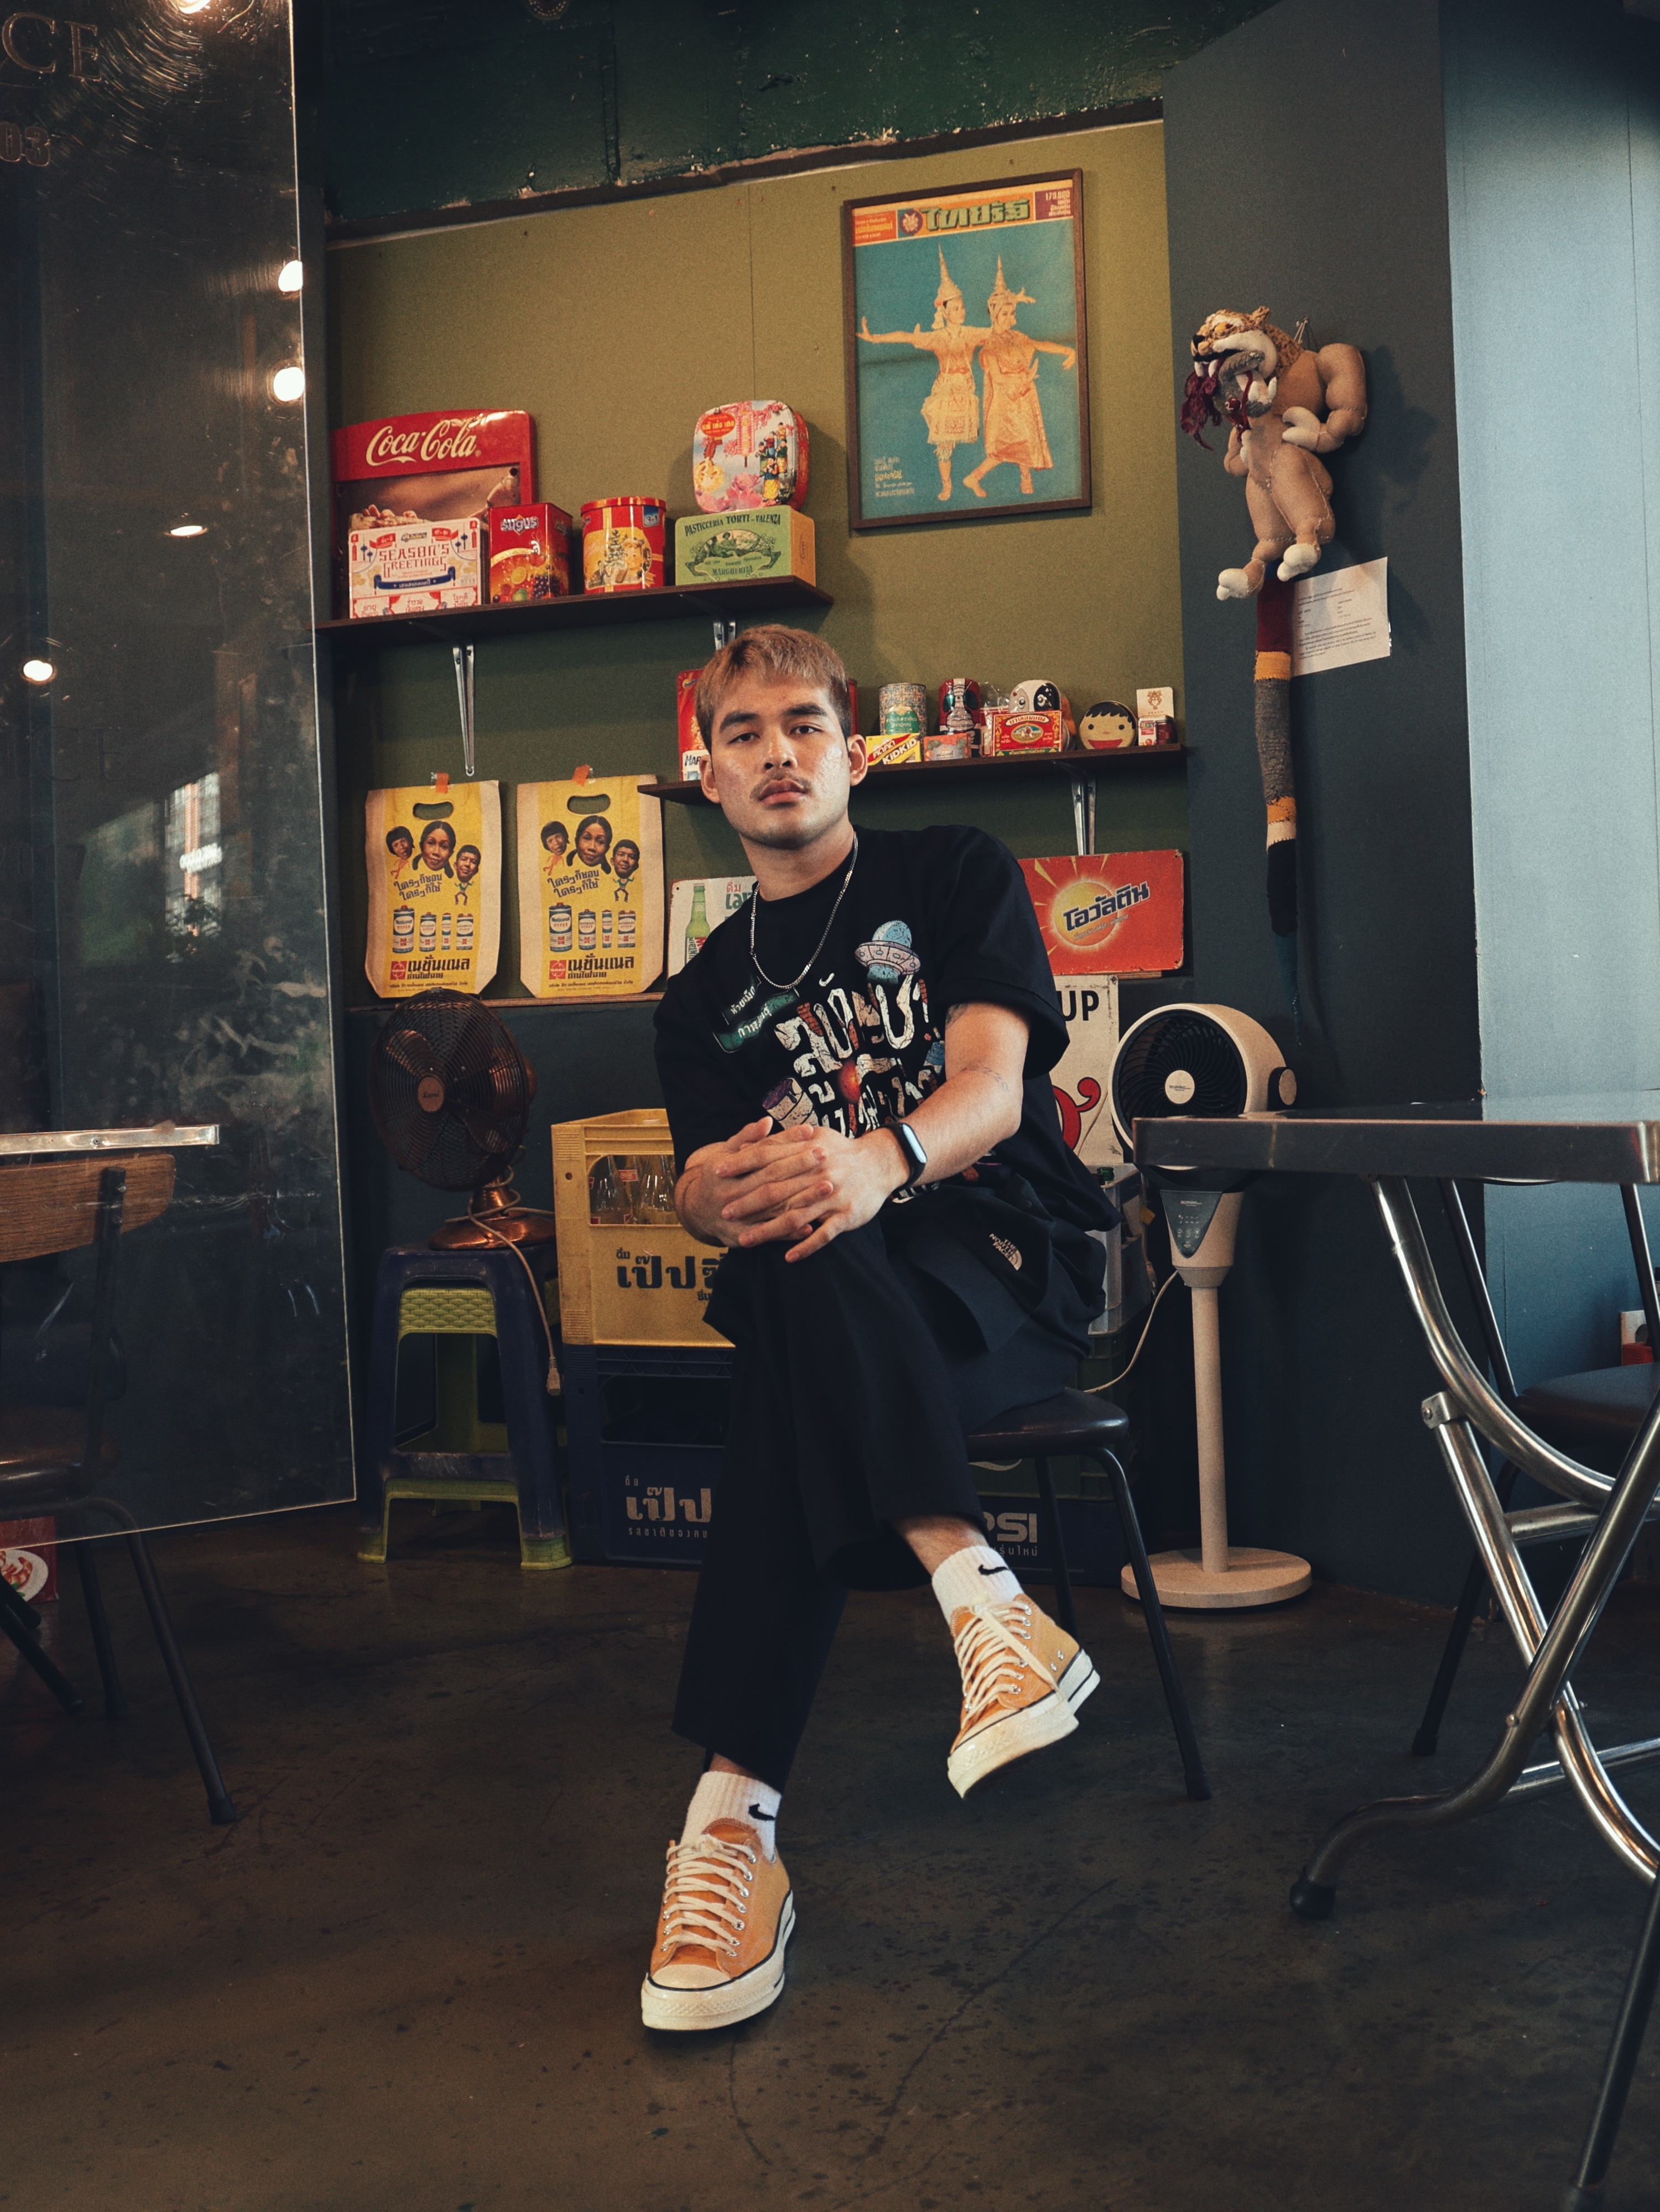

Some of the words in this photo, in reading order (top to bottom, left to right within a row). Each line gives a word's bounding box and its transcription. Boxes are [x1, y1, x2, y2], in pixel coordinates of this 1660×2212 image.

[366, 419, 478, 466] Coca-Cola
[684, 519, 724, 536] PASTICCERIA
[726, 514, 750, 524] TORTI
[756, 514, 781, 525] VALENZA
[379, 544, 449, 562] SEASON'S
[383, 556, 446, 578] GREETINGS
[684, 679, 699, 687] Ovalti
[726, 879, 741, 893] ดื่ม
[1063, 881, 1150, 932] โอวัลติน
[408, 954, 470, 972] เนชั่นแนล
[568, 953, 634, 971] เนชั่นแนล
[616, 1247, 631, 1259] ดื่ม
[989, 1233, 1014, 1255] NORTH
[992, 1243, 1012, 1259] FACE
[1004, 1238, 1017, 1250] THE
[617, 1253, 727, 1289] เป๊ป
[626, 1487, 712, 1523] เป๊ป
